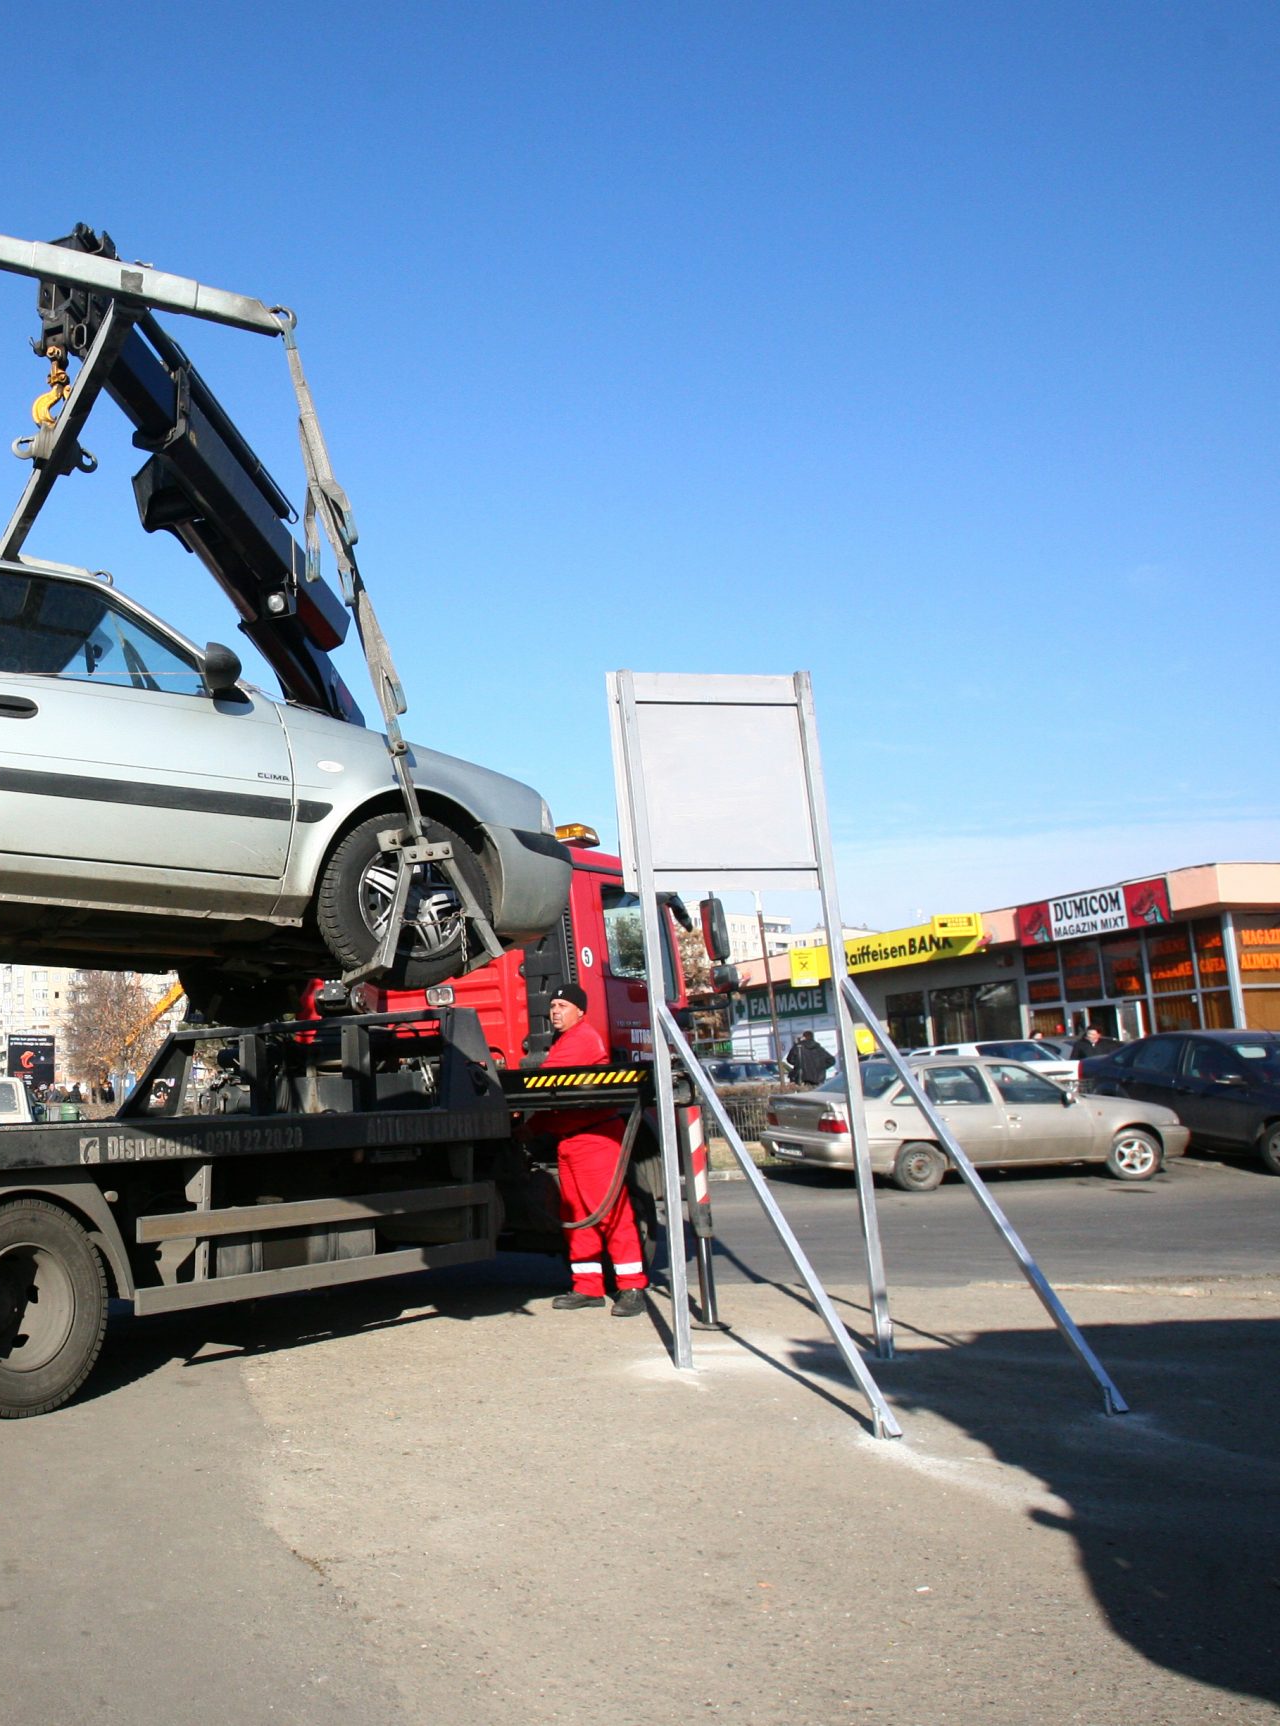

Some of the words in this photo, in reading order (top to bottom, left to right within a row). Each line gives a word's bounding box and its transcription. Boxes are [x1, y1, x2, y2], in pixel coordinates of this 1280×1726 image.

[257, 772, 290, 782] CLIMA
[1053, 890, 1122, 922] DUMICOM
[1054, 920, 1098, 938] MAGAZIN
[1100, 915, 1125, 930] MIXT
[584, 950, 590, 964] 5
